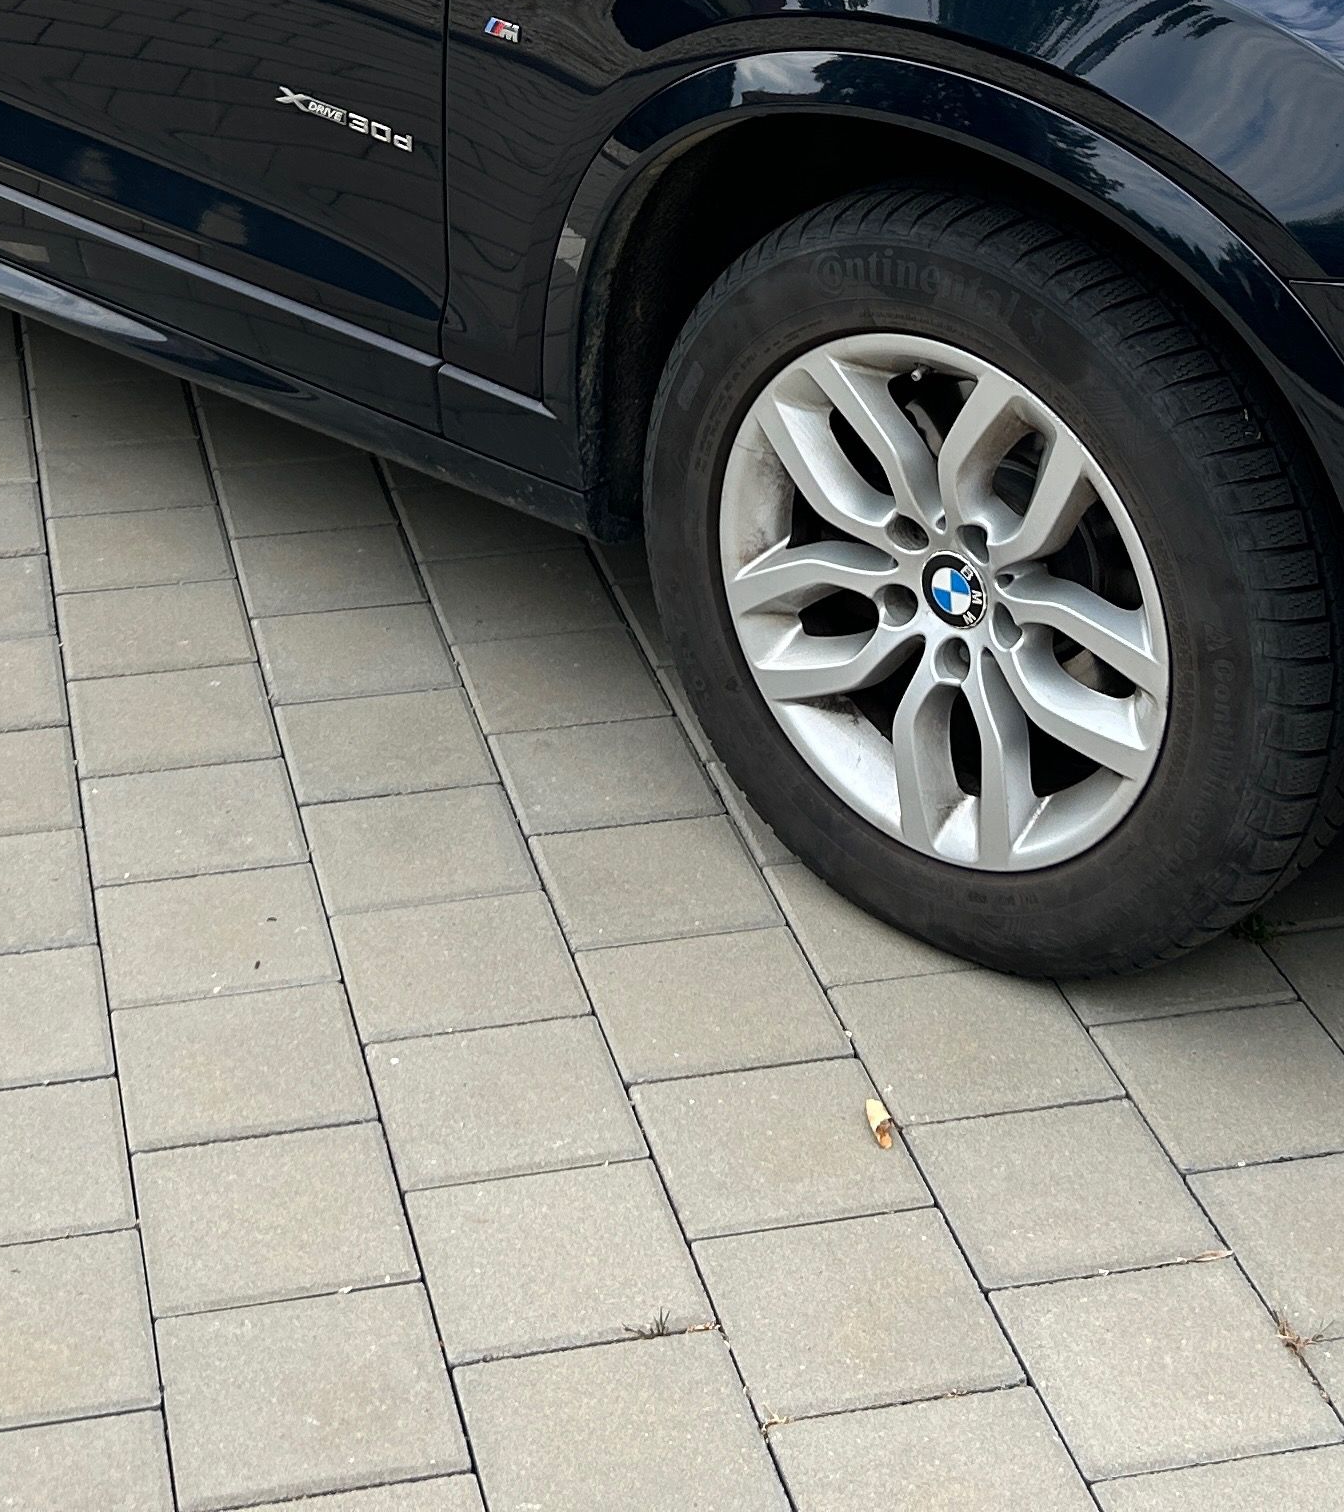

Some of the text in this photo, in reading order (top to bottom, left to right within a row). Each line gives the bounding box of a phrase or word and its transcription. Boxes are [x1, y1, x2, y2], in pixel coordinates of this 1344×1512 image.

[348, 112, 414, 152] 30d
[810, 248, 1021, 325] Continental
[960, 564, 984, 626] BMW
